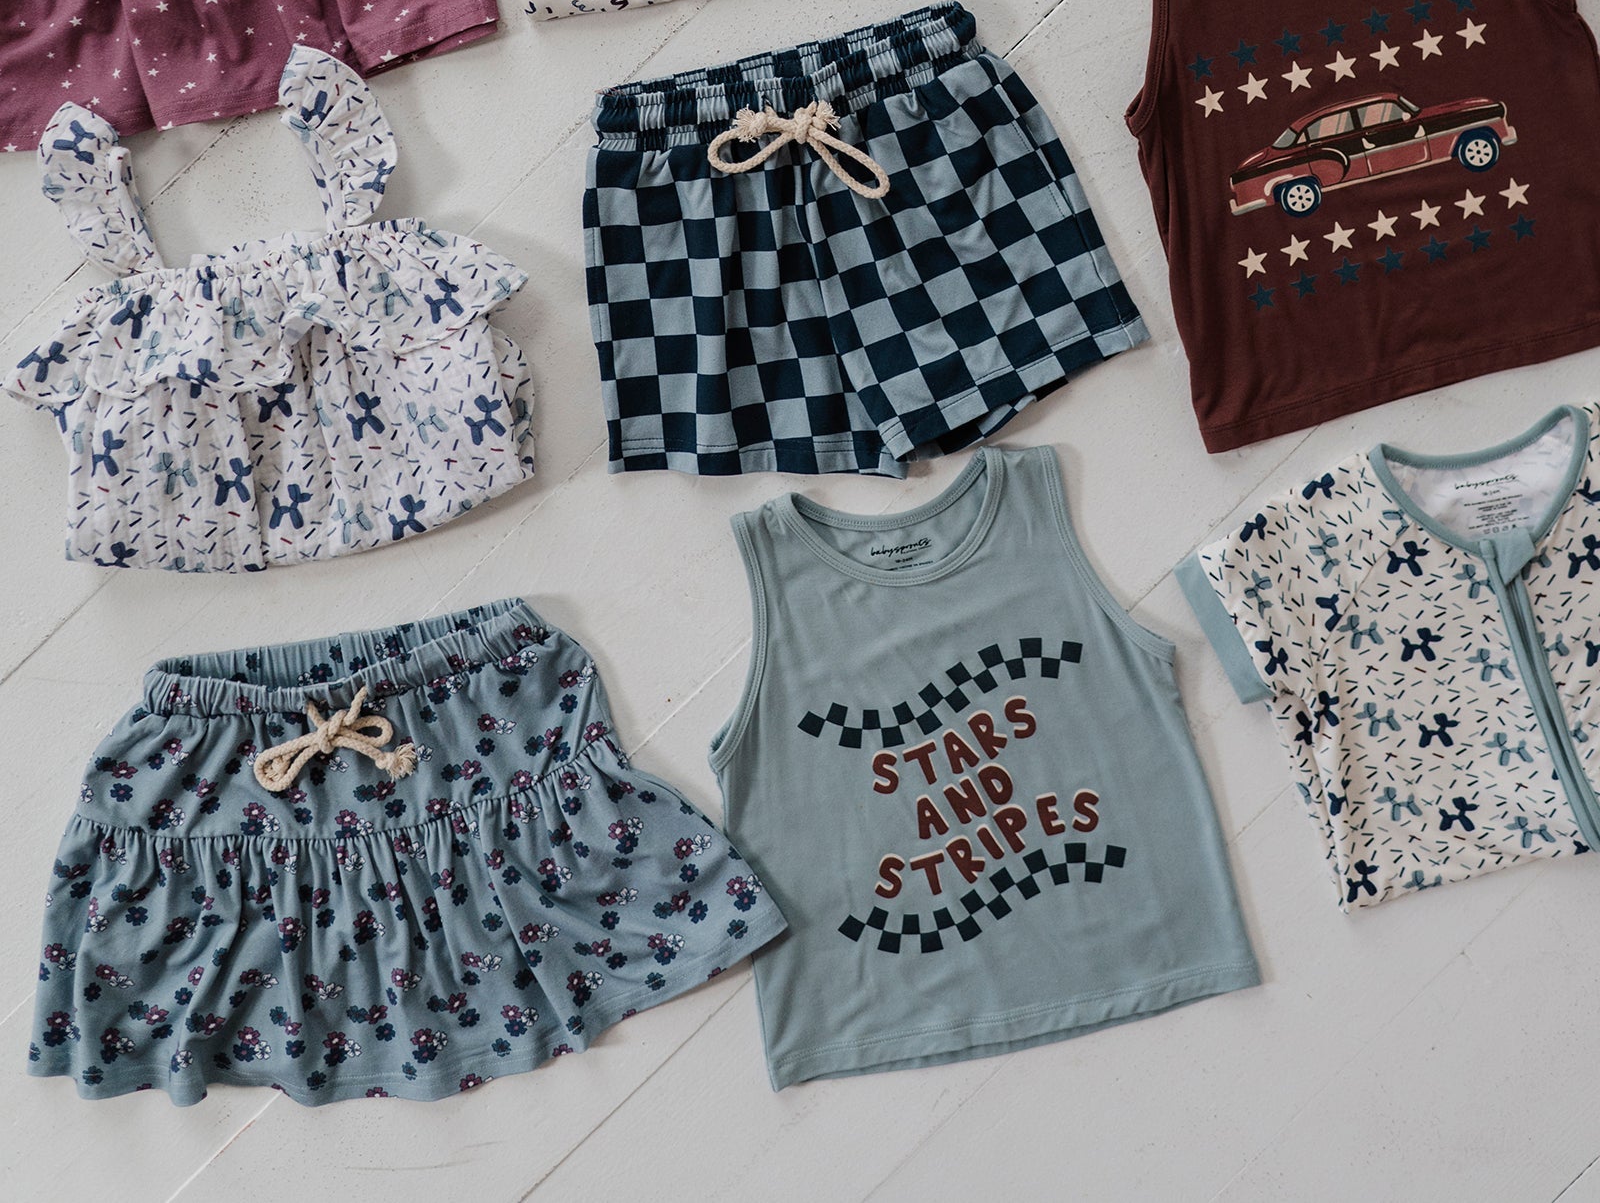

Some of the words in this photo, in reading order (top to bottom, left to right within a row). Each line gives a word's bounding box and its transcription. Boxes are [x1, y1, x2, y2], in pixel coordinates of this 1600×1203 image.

[1455, 474, 1518, 490] babysprouts
[871, 537, 932, 558] babysprouts
[872, 695, 1036, 795] STARS
[916, 762, 1014, 840] AND
[874, 788, 1100, 899] STRIPES
